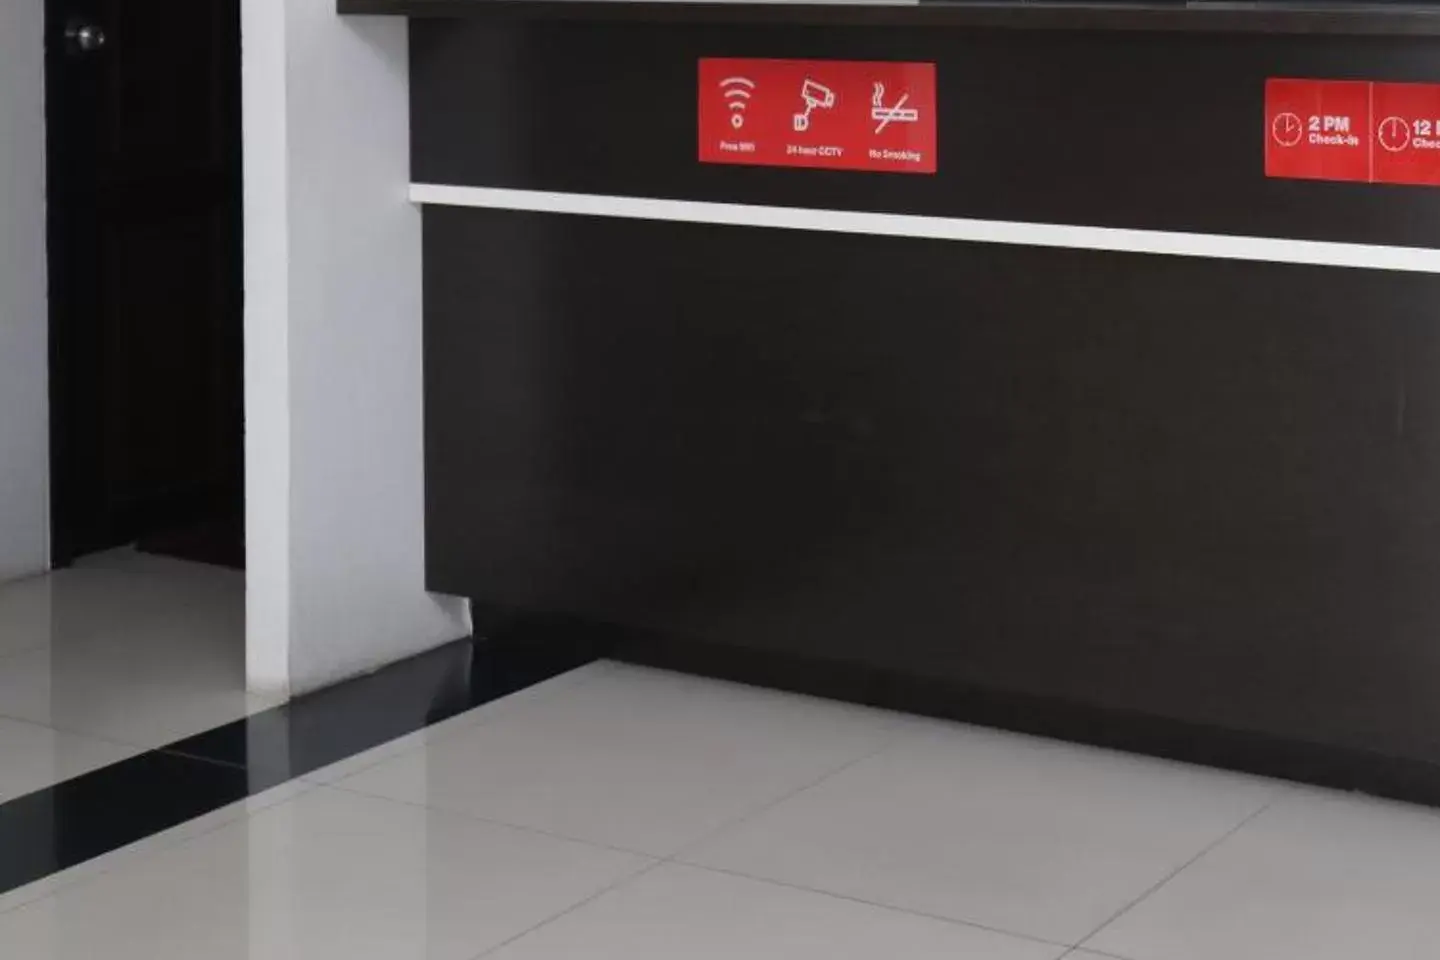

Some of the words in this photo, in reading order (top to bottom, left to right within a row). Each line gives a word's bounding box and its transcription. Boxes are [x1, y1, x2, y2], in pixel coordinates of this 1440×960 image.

[1308, 115, 1320, 131] 2
[1323, 115, 1350, 132] PM
[1412, 119, 1431, 136] 12
[1308, 132, 1359, 147] Check-in
[818, 146, 844, 157] CCTV
[869, 148, 881, 158] No
[882, 149, 921, 162] Smoking
